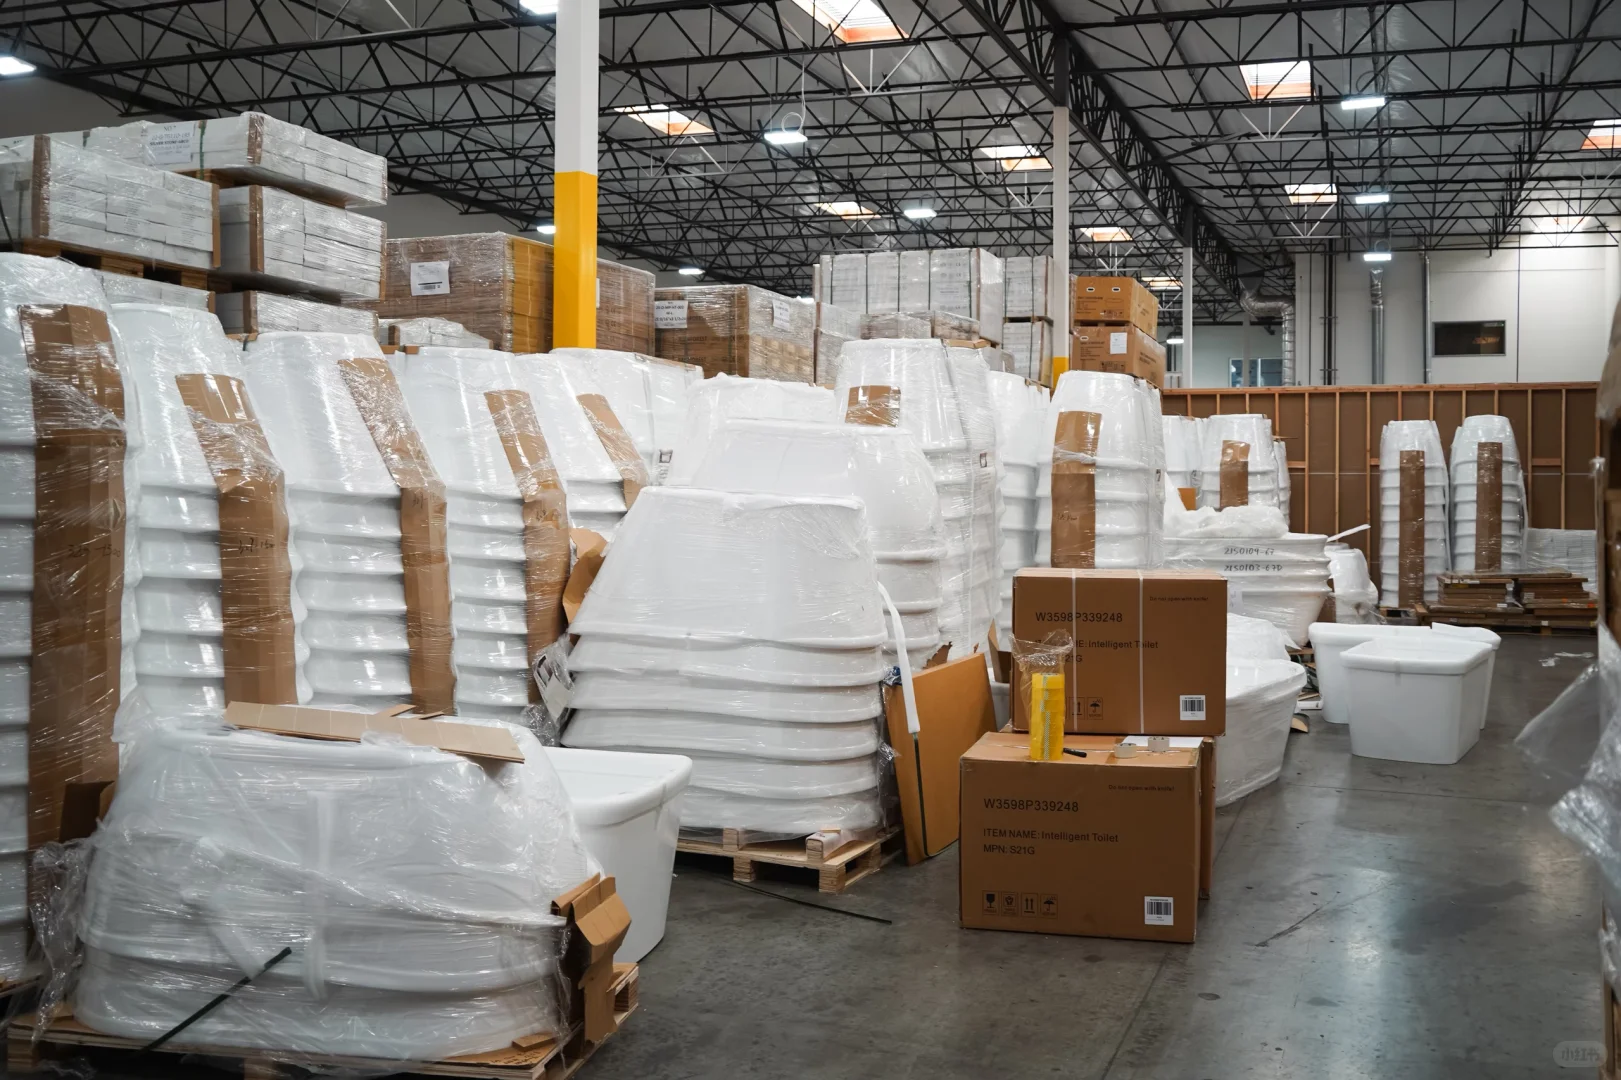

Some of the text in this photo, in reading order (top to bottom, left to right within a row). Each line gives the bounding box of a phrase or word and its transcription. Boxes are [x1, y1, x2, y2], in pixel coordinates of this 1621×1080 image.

[1036, 612, 1123, 622] W3598P339248
[1088, 640, 1132, 650] Intelligent
[984, 798, 1079, 812] W3598P339248
[984, 828, 1118, 842] ITEM NAME: Intelligent Toilet
[984, 844, 1035, 854] MPN: S21G
